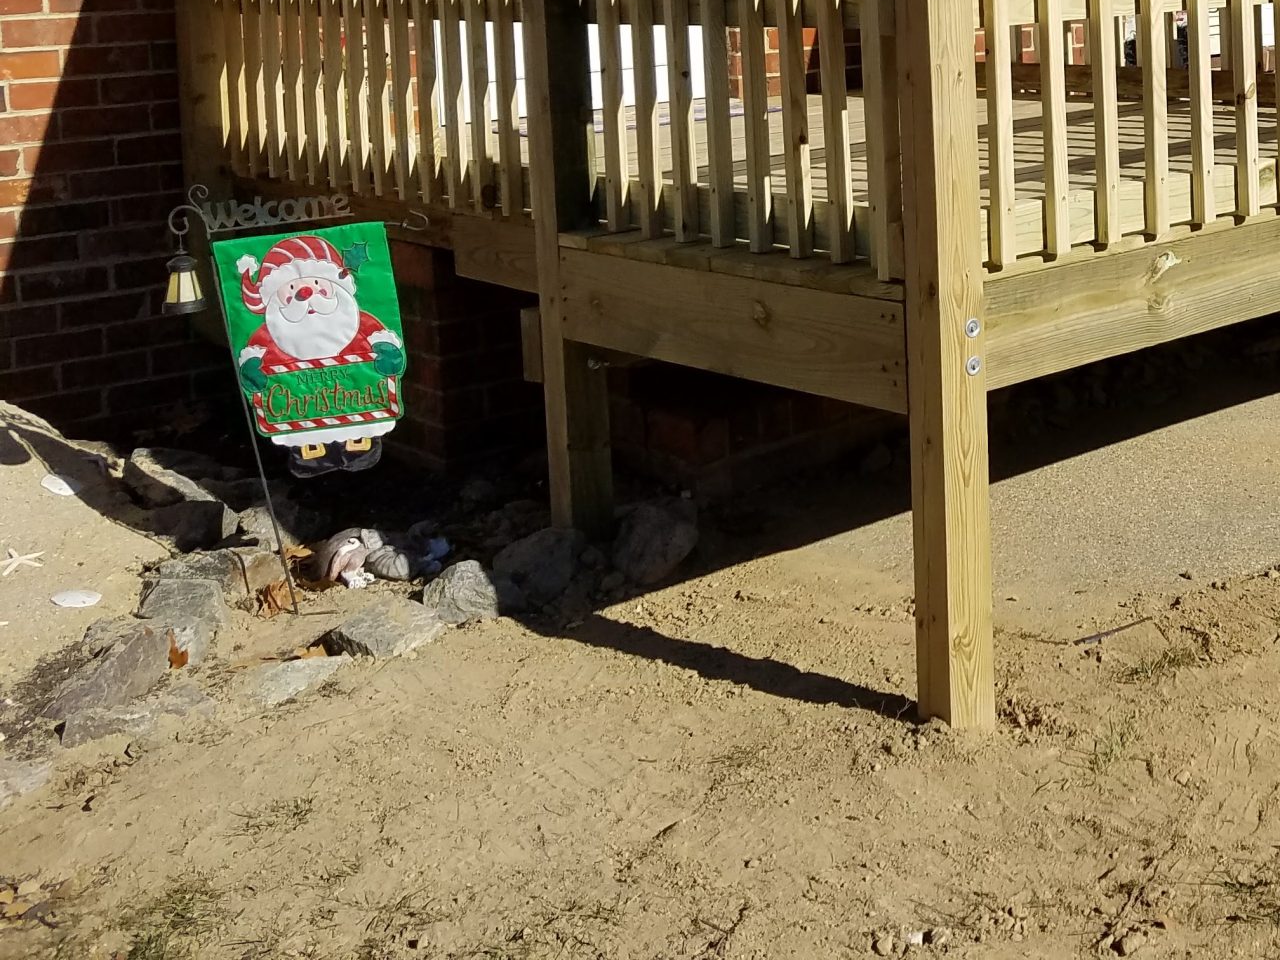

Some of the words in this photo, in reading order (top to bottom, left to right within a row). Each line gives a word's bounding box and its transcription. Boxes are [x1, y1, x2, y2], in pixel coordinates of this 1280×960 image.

[201, 193, 351, 229] Welcome
[296, 368, 350, 385] MERRY
[267, 378, 387, 418] Christmas
